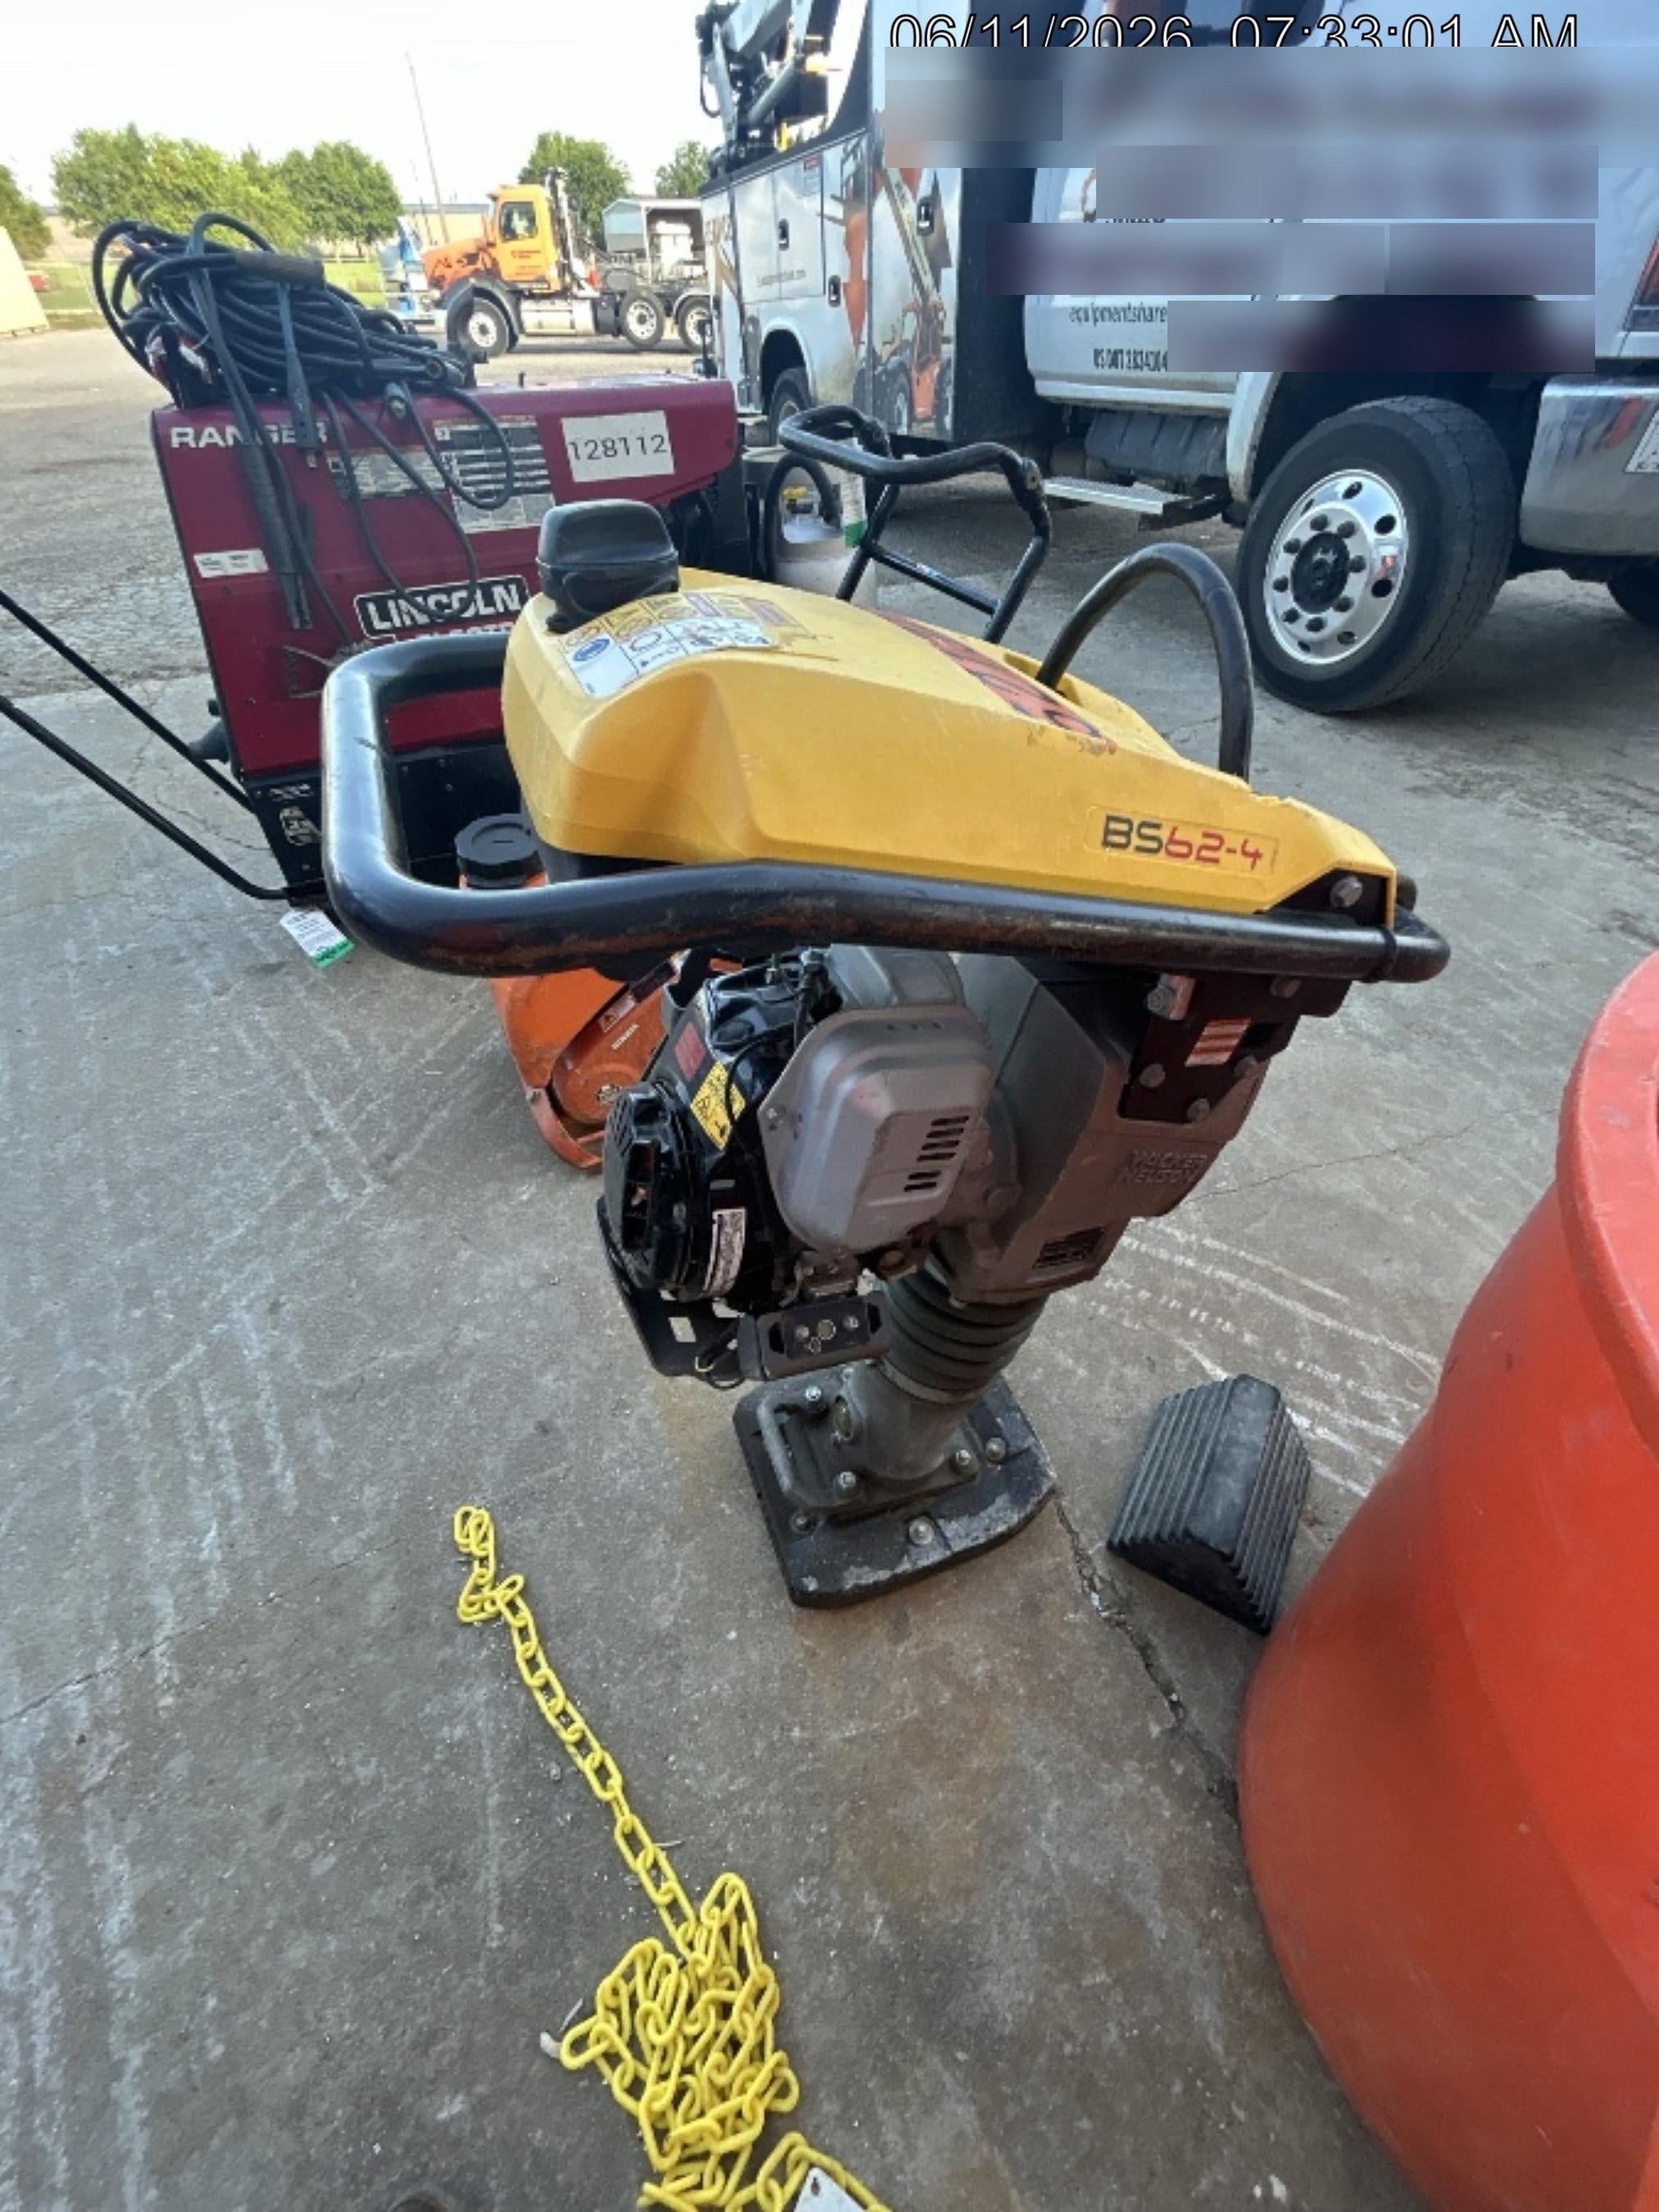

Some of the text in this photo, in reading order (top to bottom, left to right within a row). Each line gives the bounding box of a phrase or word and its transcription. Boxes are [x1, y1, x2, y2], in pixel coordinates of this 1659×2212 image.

[568, 433, 669, 461] 128112
[365, 582, 522, 631] LINCOLN
[1102, 814, 1263, 871] BS62-4
